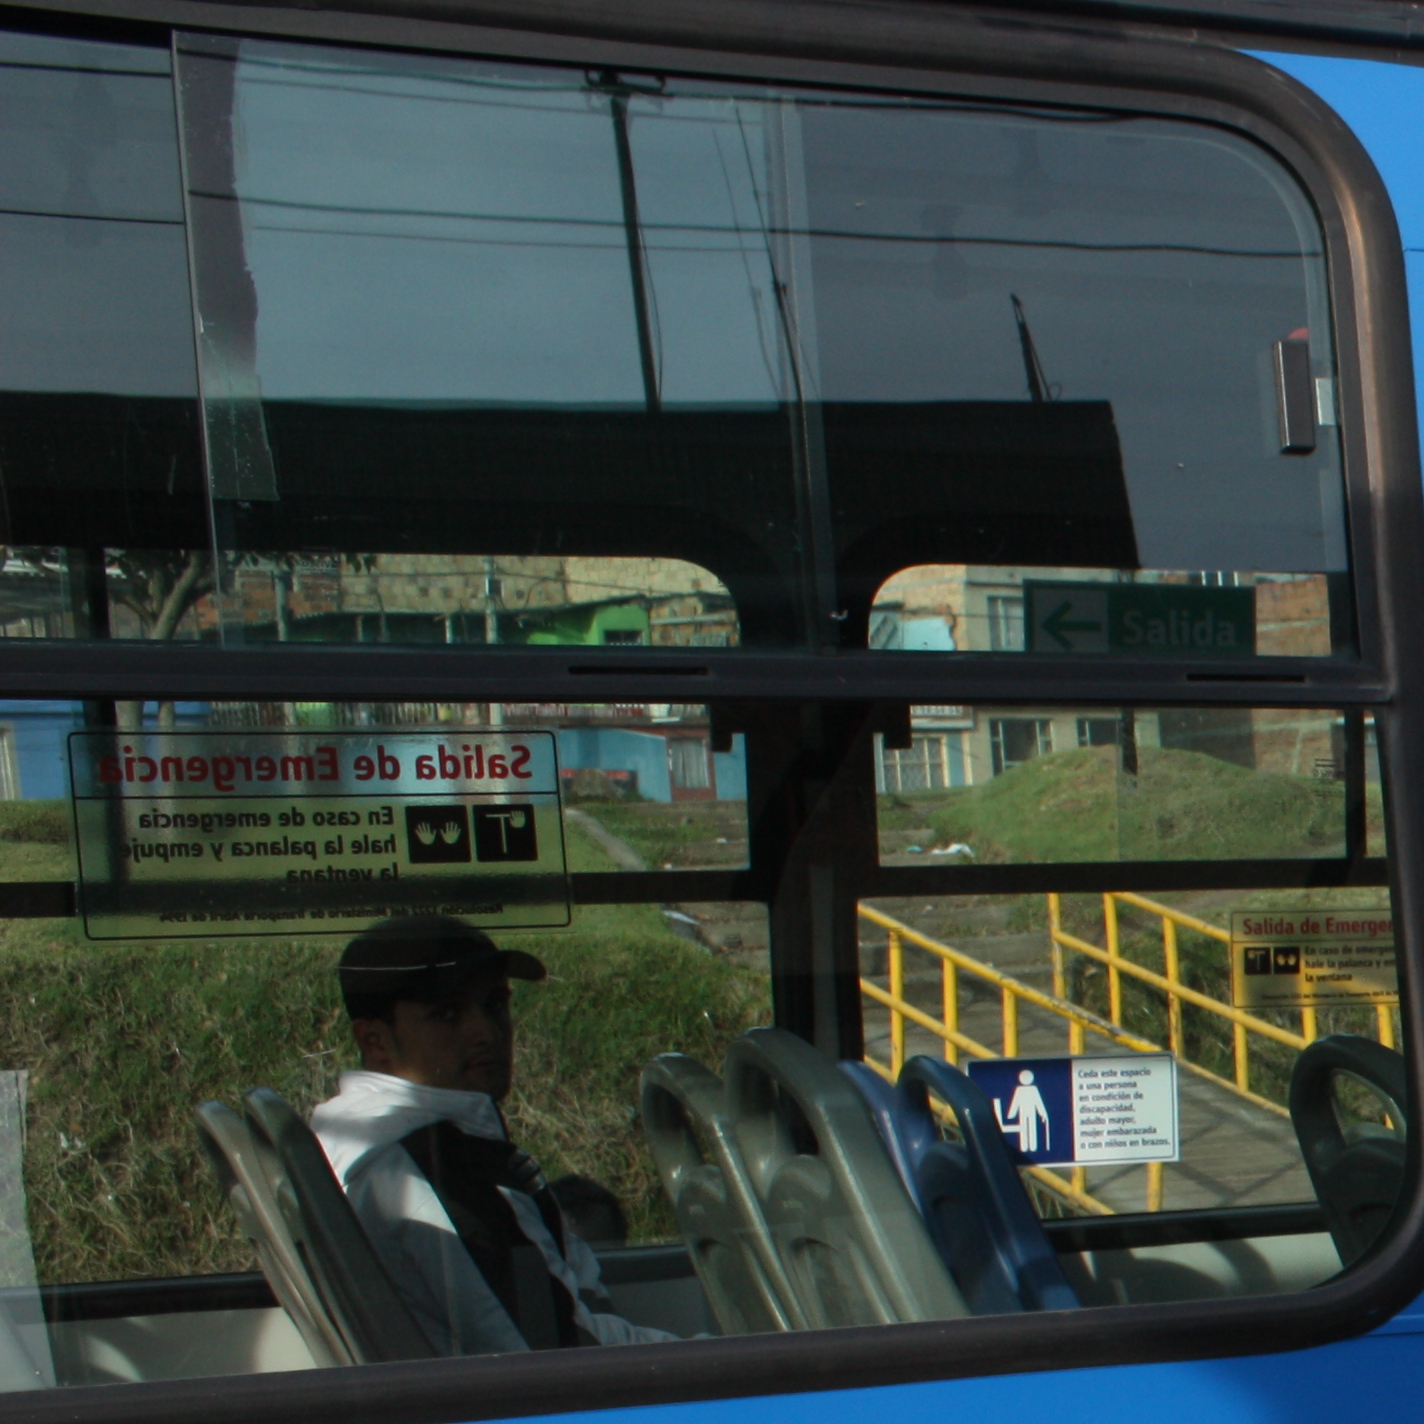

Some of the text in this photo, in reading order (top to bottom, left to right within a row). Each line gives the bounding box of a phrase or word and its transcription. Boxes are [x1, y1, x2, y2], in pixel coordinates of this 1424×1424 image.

[1122, 608, 1236, 647] Salida
[1243, 917, 1295, 936] Salida
[1300, 917, 1320, 935] de
[1077, 1067, 1152, 1079] Ceda este espacio
[1086, 1083, 1102, 1091] una
[1104, 1081, 1137, 1091] persona
[1133, 1091, 1143, 1100] de
[1106, 1126, 1157, 1136] embarazada
[1088, 1141, 1103, 1149] con
